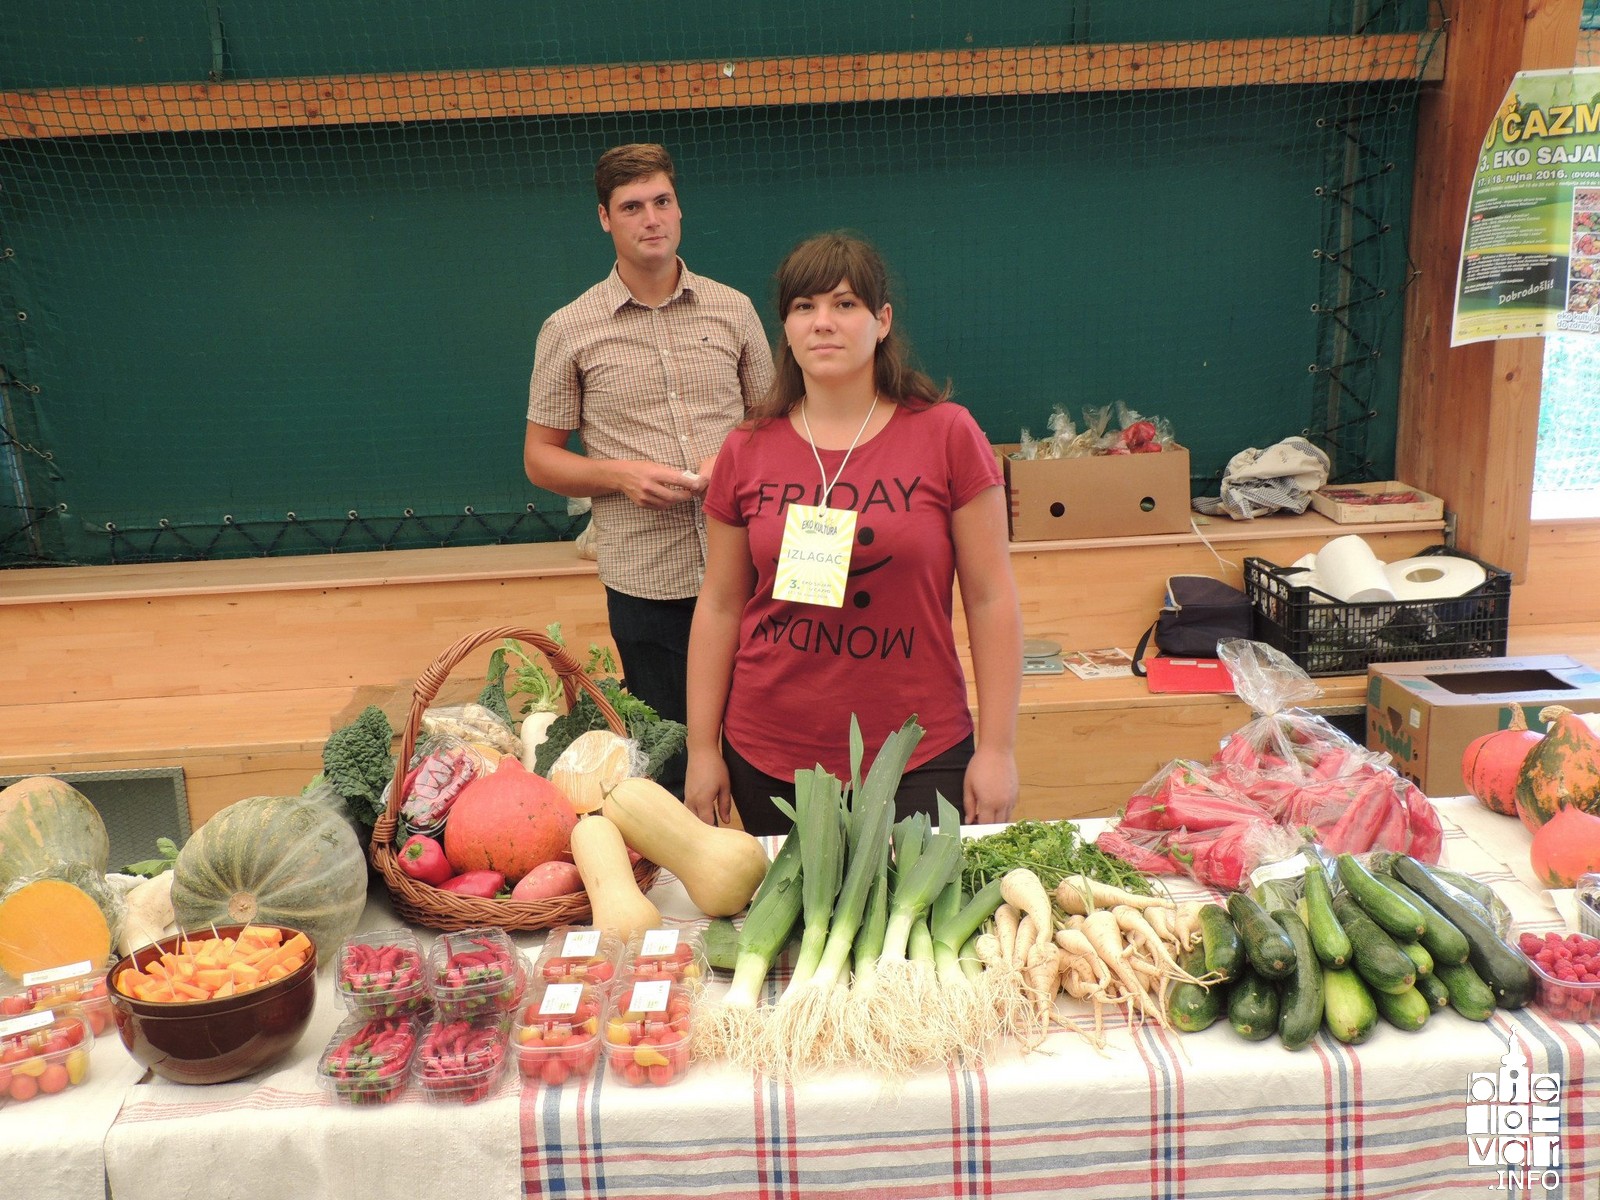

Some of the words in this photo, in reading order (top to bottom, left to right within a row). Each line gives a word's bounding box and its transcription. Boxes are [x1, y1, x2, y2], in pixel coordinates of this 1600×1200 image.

[1485, 117, 1498, 150] U
[1479, 154, 1490, 173] 3.
[1493, 148, 1531, 169] EKO
[1537, 145, 1600, 165] SAJA
[1477, 177, 1487, 187] 17.
[1492, 174, 1504, 184] 18.
[1505, 172, 1533, 184] rujna
[1536, 170, 1568, 180] 2016.
[1497, 278, 1555, 306] Dobrodošli!
[755, 476, 921, 516] FRIDAY
[801, 520, 813, 530] EKO
[813, 522, 838, 536] KULTURA
[789, 579, 800, 589] 3.
[752, 614, 914, 660] MONDAY
